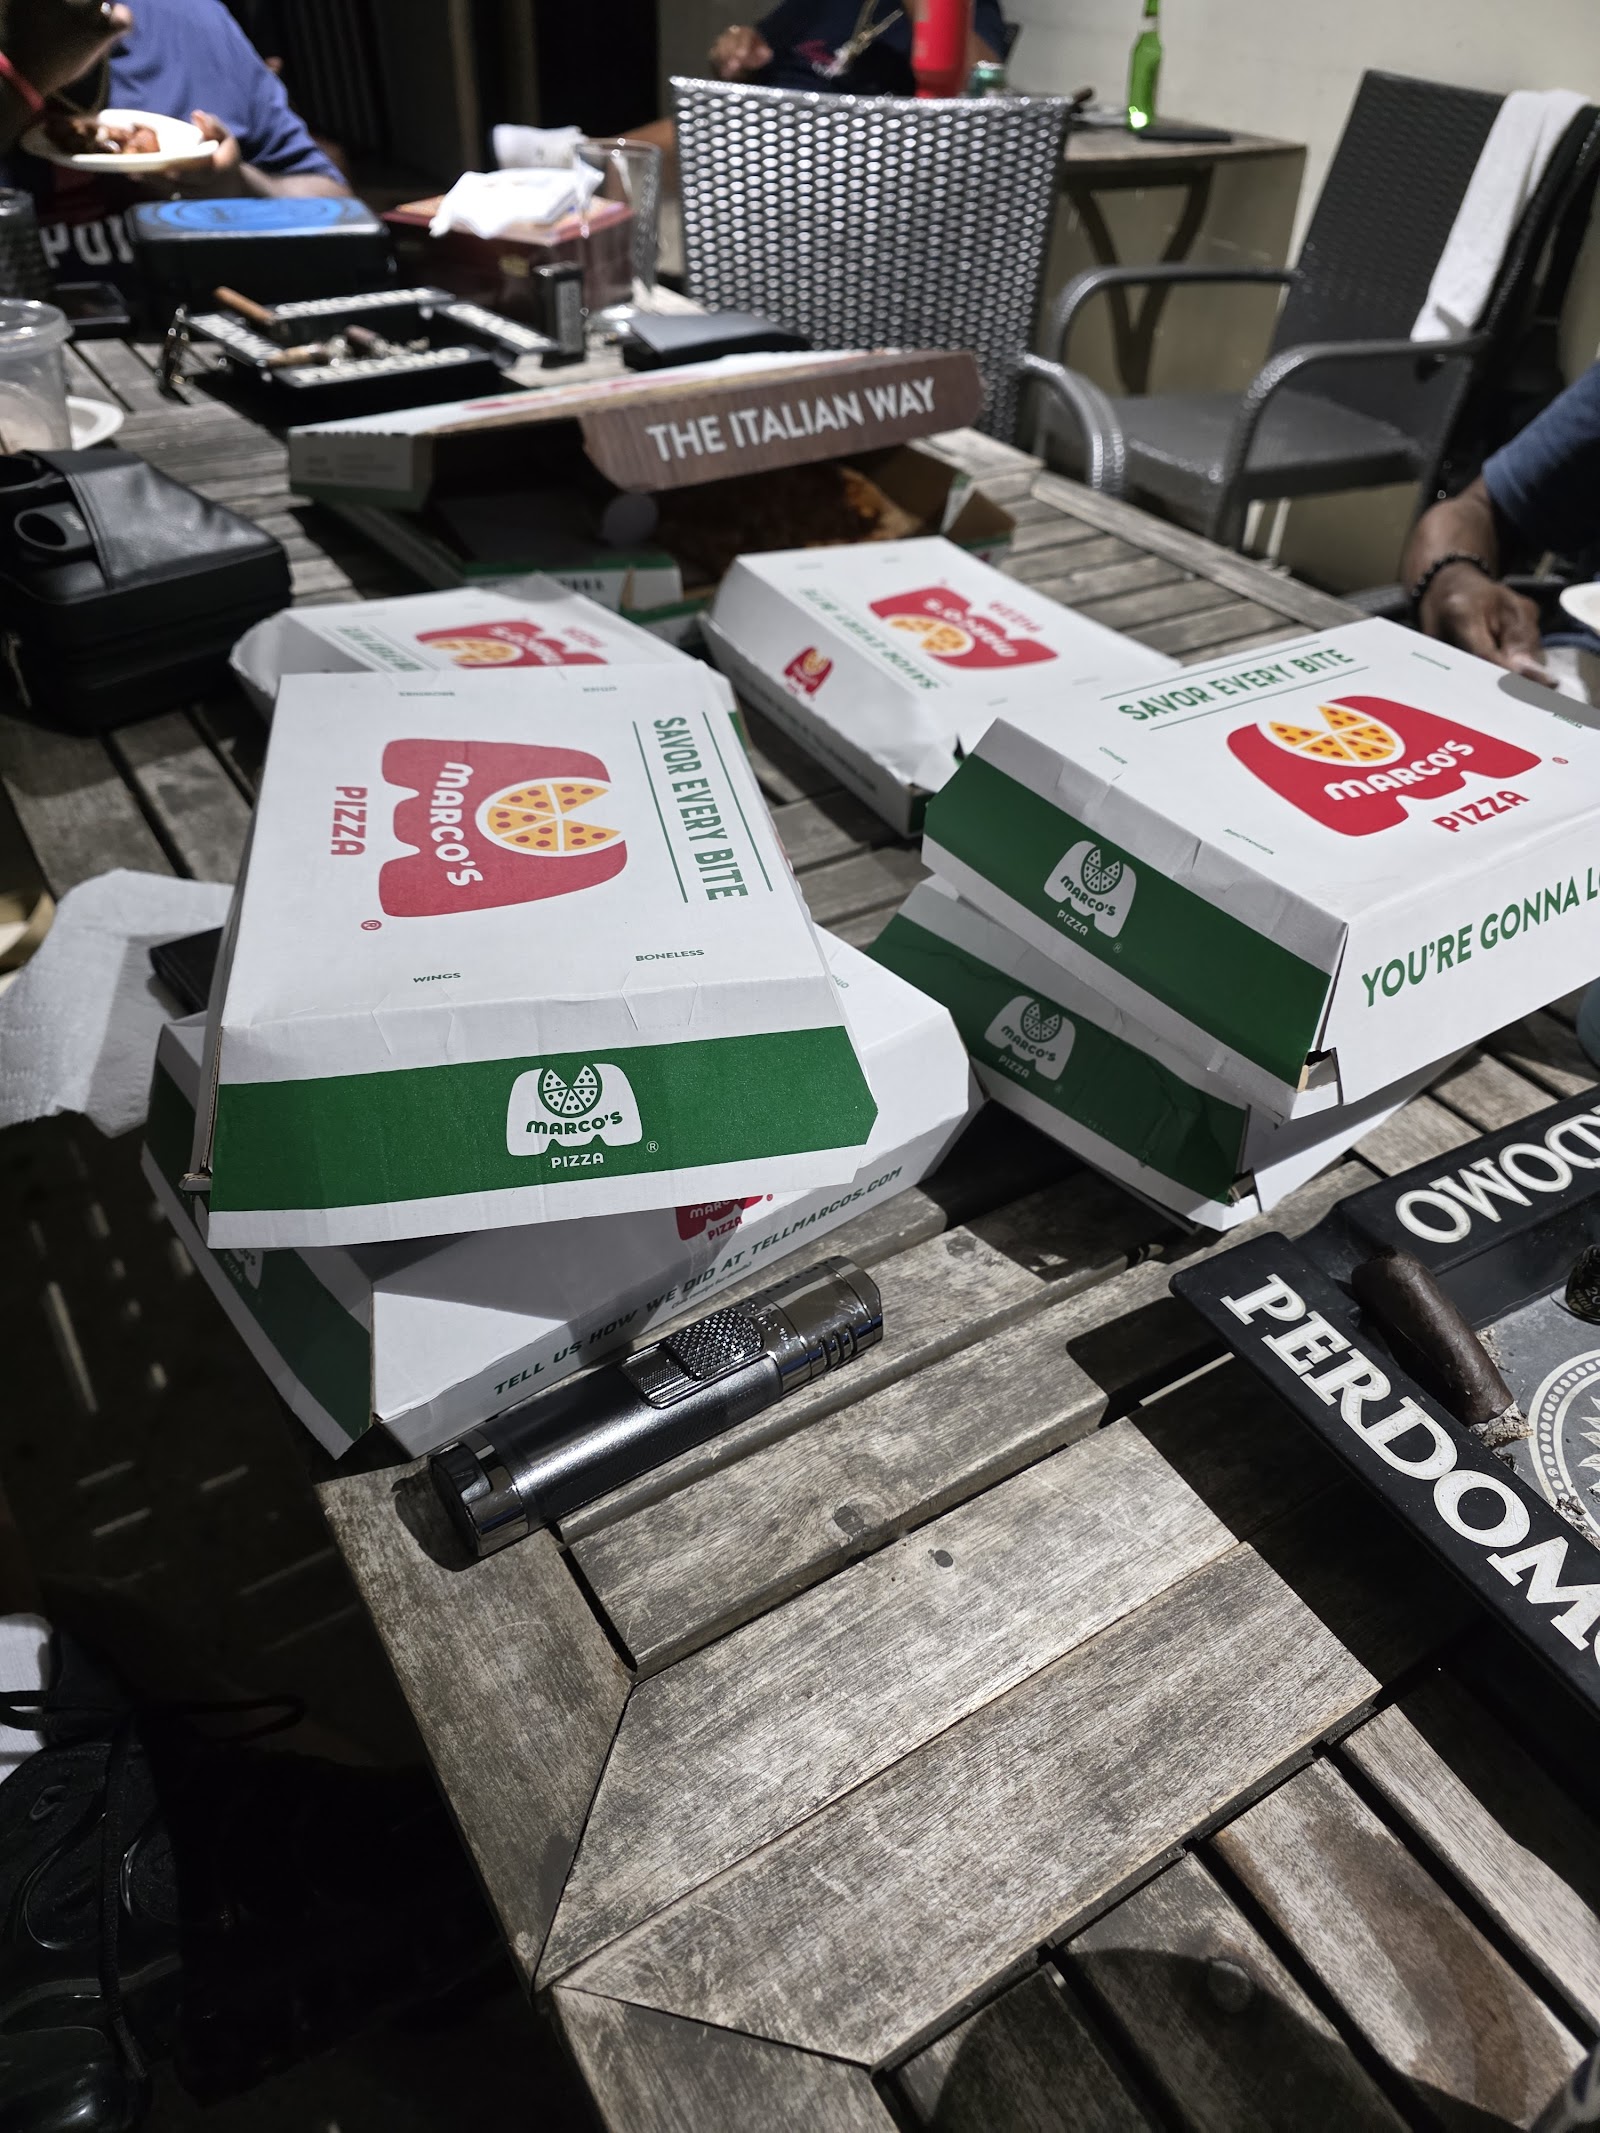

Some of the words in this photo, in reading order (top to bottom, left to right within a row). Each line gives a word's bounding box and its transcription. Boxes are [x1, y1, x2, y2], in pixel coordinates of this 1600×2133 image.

[645, 415, 727, 462] THE
[729, 390, 865, 448] ITALIAN
[864, 376, 935, 422] WAY
[1118, 684, 1212, 722] SAVOR
[1208, 664, 1296, 698] EVERY
[1291, 648, 1356, 674] BITE
[653, 716, 702, 776] SAVOR
[1323, 740, 1475, 801] MARCO'S
[330, 786, 368, 856] PIZZA
[429, 762, 484, 887] MARCO'S
[671, 776, 729, 843] EVERY
[1431, 790, 1530, 833] PIZZA
[693, 846, 749, 901] BITE
[1060, 875, 1117, 917] MARCO'S
[1056, 909, 1089, 936] PIZZA
[1361, 923, 1473, 1008] YOU'RE
[1480, 875, 1580, 950] GONNA
[1586, 867, 1600, 901] L
[412, 972, 462, 983] WINGS
[635, 949, 705, 962] BONELESS
[998, 1055, 1030, 1079] PIZZA
[1001, 1025, 1057, 1062] MARCO'S
[526, 1111, 623, 1135] MARCO'S
[551, 1152, 605, 1169] PIZZA
[1395, 1105, 1600, 1244] DOMO
[707, 1216, 743, 1241] PIZZA
[493, 1362, 546, 1396] TELL
[553, 1341, 582, 1364] US
[588, 1308, 640, 1343] HOW
[645, 1287, 678, 1313] WE
[682, 1267, 716, 1293] DID
[720, 1250, 746, 1273] AT
[751, 1166, 903, 1255] TELLMARCOS.COM
[1219, 1272, 1600, 1672] PERDOM
